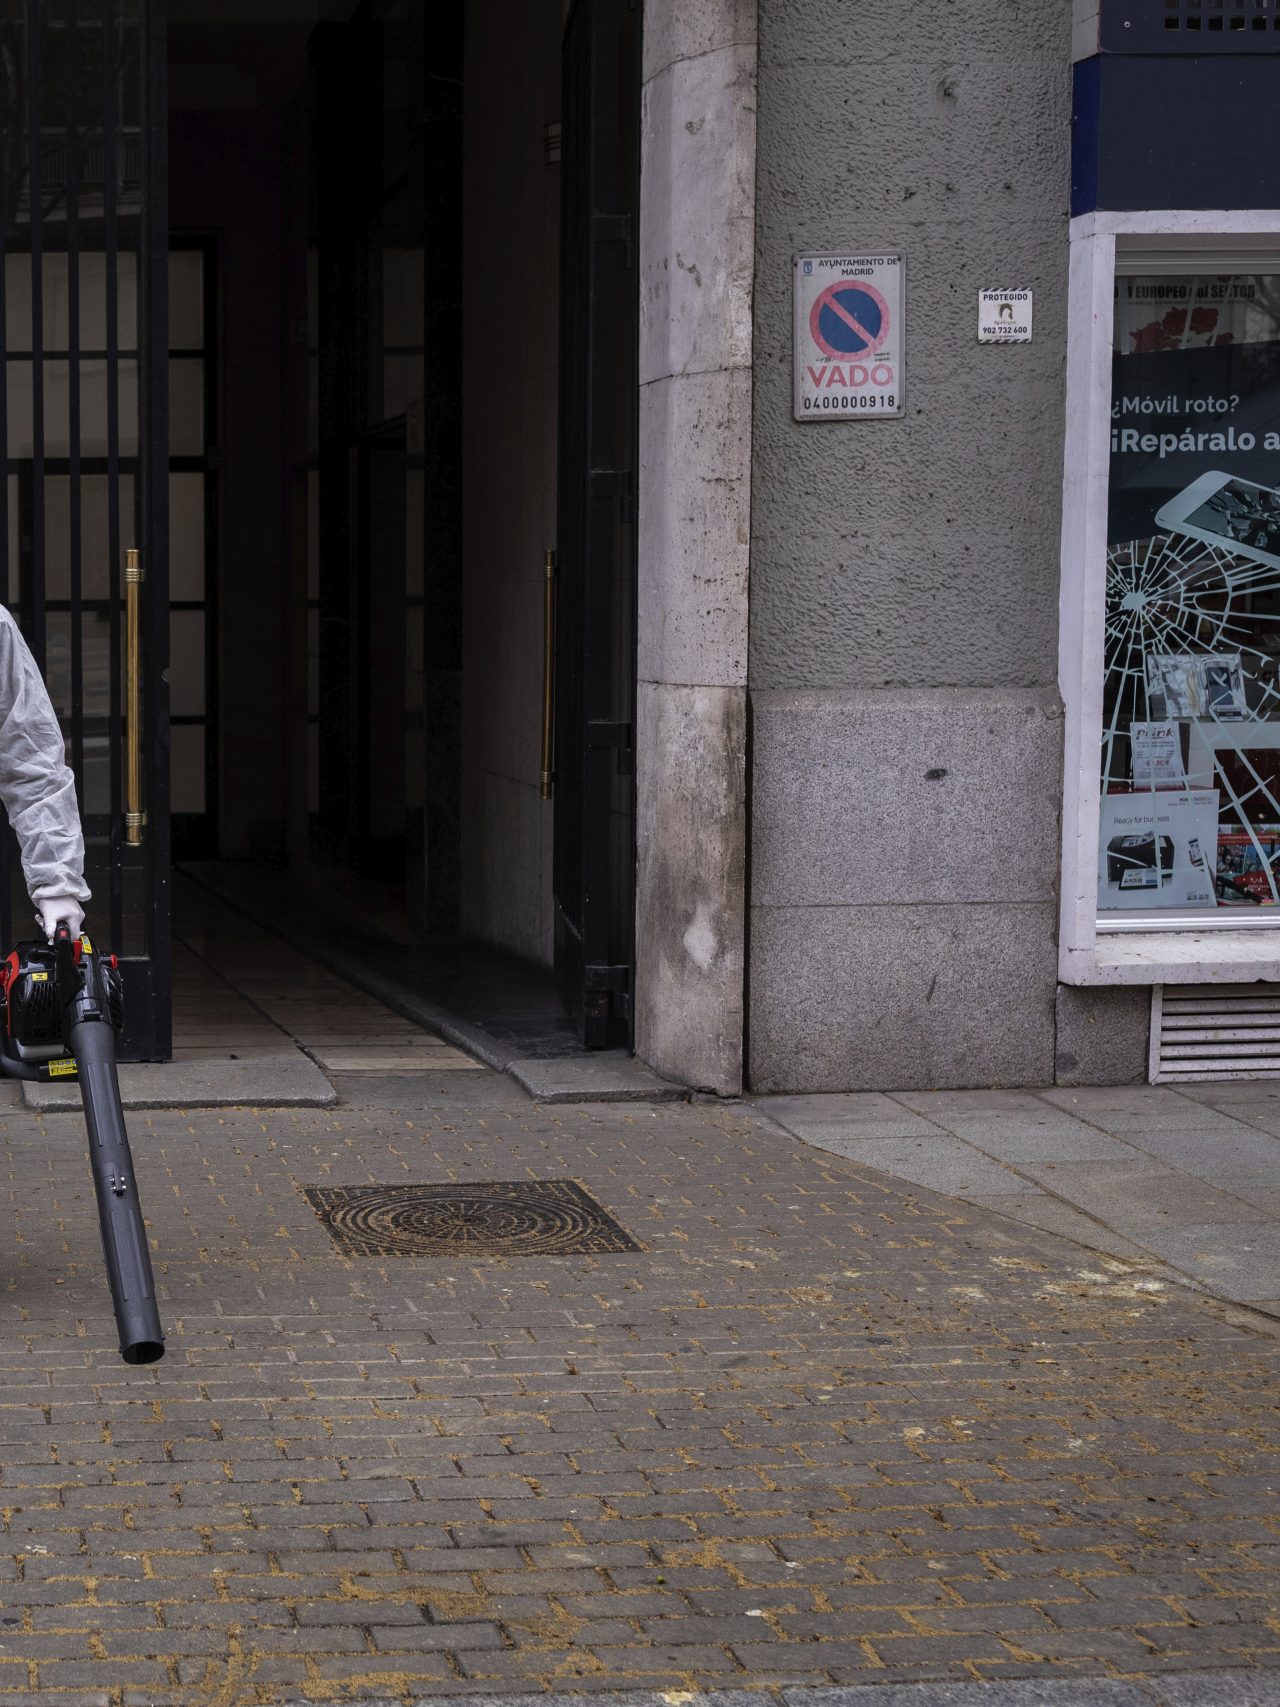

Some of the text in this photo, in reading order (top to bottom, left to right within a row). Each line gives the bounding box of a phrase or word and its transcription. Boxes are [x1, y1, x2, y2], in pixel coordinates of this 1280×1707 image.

[818, 258, 884, 267] AYUNTAMIENTO
[841, 268, 874, 276] MADRID
[983, 293, 1028, 301] PROTEGIDO
[1135, 285, 1187, 298] EUROPEO
[998, 326, 1012, 334] 732
[806, 364, 894, 388] VADO
[804, 395, 895, 410] 0400000918
[1111, 394, 1240, 419] ¿Móvil roto?
[1112, 427, 1256, 459] ¡Repáralo
